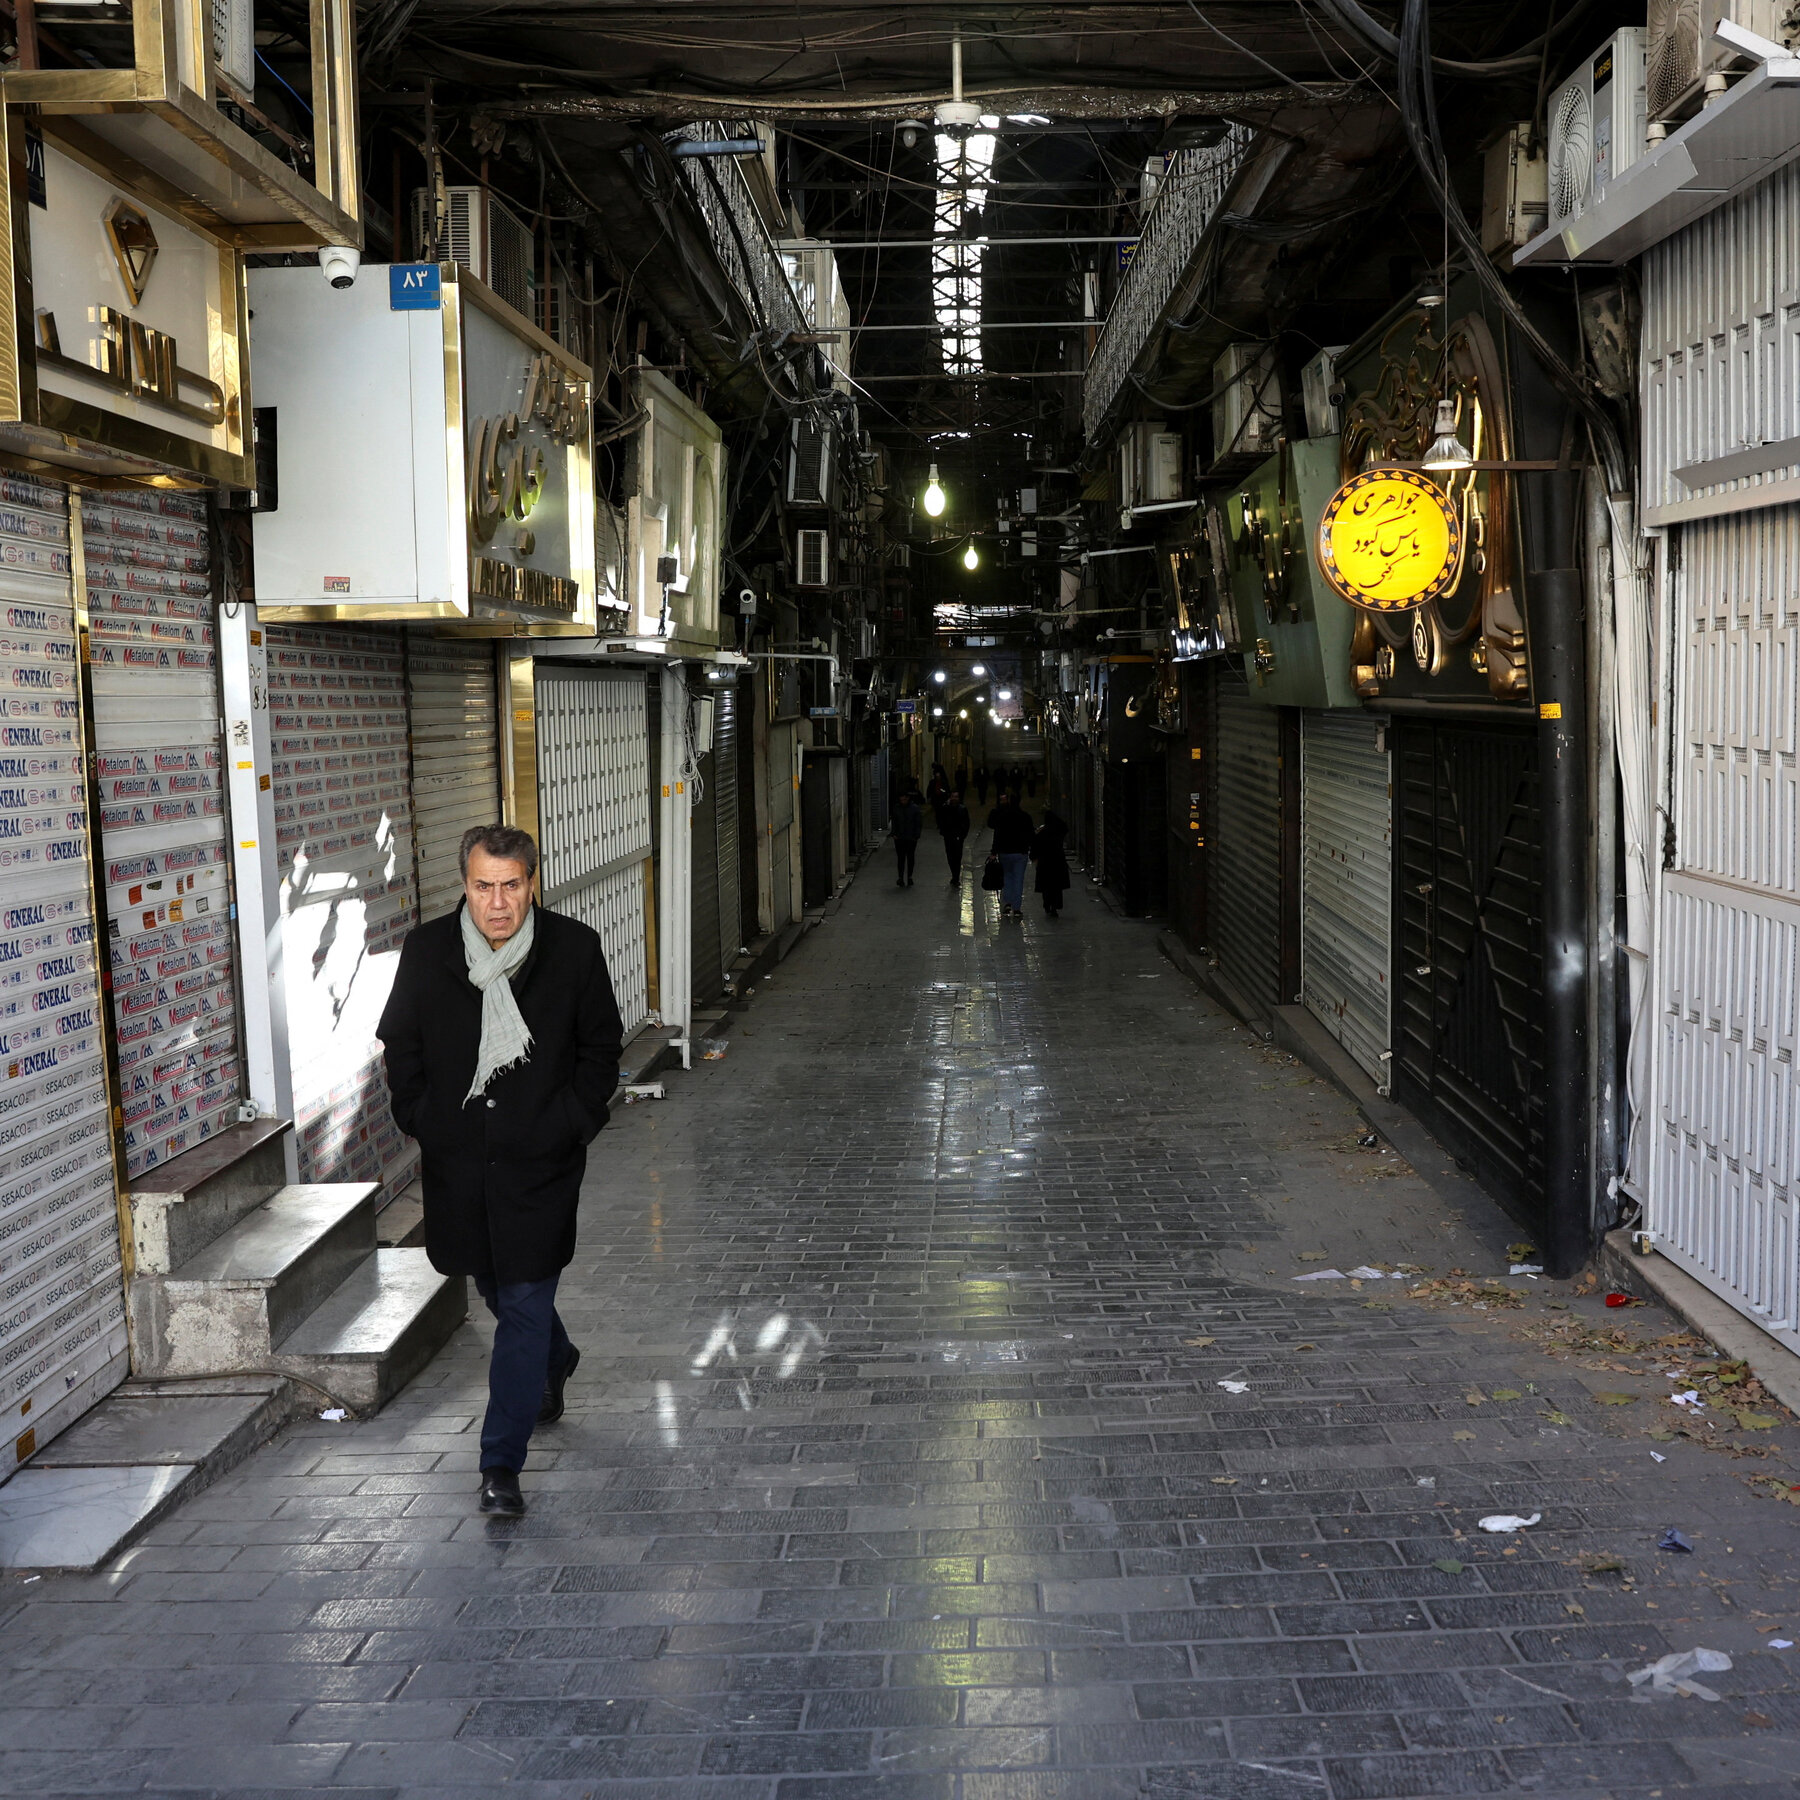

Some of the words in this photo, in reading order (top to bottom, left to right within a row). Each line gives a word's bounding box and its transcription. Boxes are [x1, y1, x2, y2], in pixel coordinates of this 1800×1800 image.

[403, 270, 428, 289] ۸۳
[1353, 490, 1420, 519] جواهری
[1352, 513, 1409, 556] کبود
[1380, 528, 1420, 557] یاس
[111, 594, 142, 613] Metalom
[7, 607, 48, 630] GENERAL
[151, 624, 180, 642] Metalom
[123, 648, 154, 668] Metalom
[177, 650, 205, 669] Metalom
[12, 668, 52, 688] GENERAL
[2, 727, 43, 746] GENERAL
[97, 758, 130, 778] Metalom
[154, 754, 183, 773] Metalom
[113, 780, 145, 800] Metalom
[169, 775, 197, 795] Metalom
[153, 803, 182, 822] Metalom
[46, 840, 82, 861] GENERAL
[4, 904, 45, 930] GENERAL
[130, 938, 160, 961] Metalom
[36, 956, 76, 981] GENERAL
[32, 984, 71, 1012] GENERAL
[122, 990, 152, 1018] Metalom
[56, 1008, 93, 1036] GENERAL
[168, 1002, 197, 1027] Metalom
[17, 1047, 58, 1078] GENERAL
[45, 1074, 74, 1095] SESACO
[171, 1077, 200, 1103] Metalom
[46, 1102, 75, 1125] SESACO
[20, 1144, 50, 1168] SESACO
[68, 1123, 96, 1145] SESACO
[1, 1182, 32, 1208] SESACO
[50, 1158, 79, 1182] SESACO
[48, 1190, 76, 1214] SESACO
[22, 1233, 52, 1259] SESACO
[70, 1206, 97, 1231] SESACO
[6, 1271, 36, 1299] SESACO
[55, 1243, 83, 1269] SESACO
[46, 1279, 75, 1306] SESACO
[4, 1336, 35, 1366] SESACO
[15, 1360, 46, 1391] SESACO
[64, 1326, 91, 1355] SESACO
